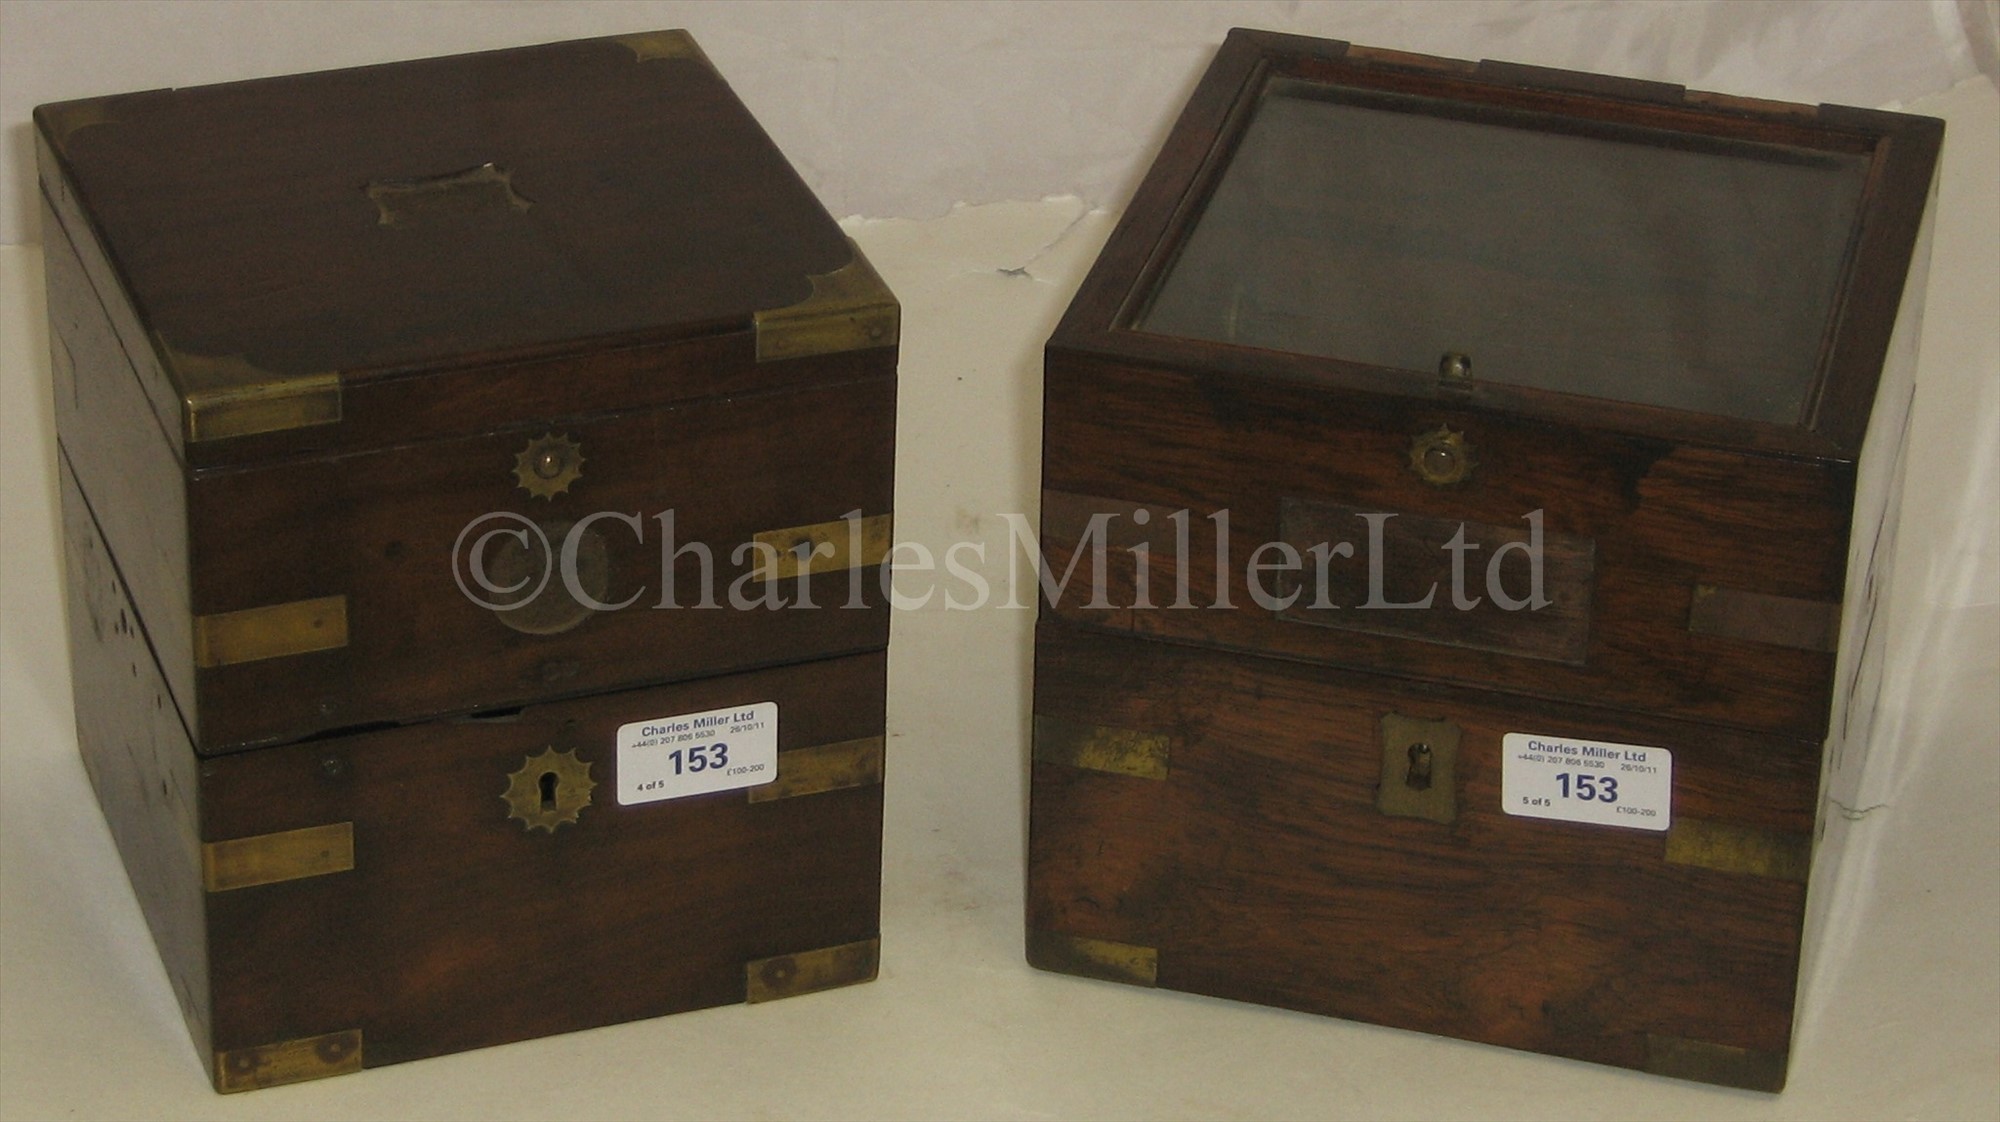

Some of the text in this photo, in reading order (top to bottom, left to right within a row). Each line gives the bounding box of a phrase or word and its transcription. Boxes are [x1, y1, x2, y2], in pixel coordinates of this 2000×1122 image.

[641, 710, 755, 737] Charles Miller Ltd
[729, 721, 765, 734] 26/10/11
[660, 736, 675, 745] 207
[695, 729, 716, 739] 5530
[1527, 740, 1647, 762] Charles Miller Ltd
[668, 742, 729, 776] 153
[1547, 755, 1563, 764] 207
[726, 763, 765, 777] £100-200
[1620, 763, 1657, 774] 26/10/11
[637, 780, 665, 791] 4 of 5
[1555, 772, 1619, 804] 153
[1522, 796, 1551, 807] 5 of 5
[1616, 806, 1657, 818] £100-200
